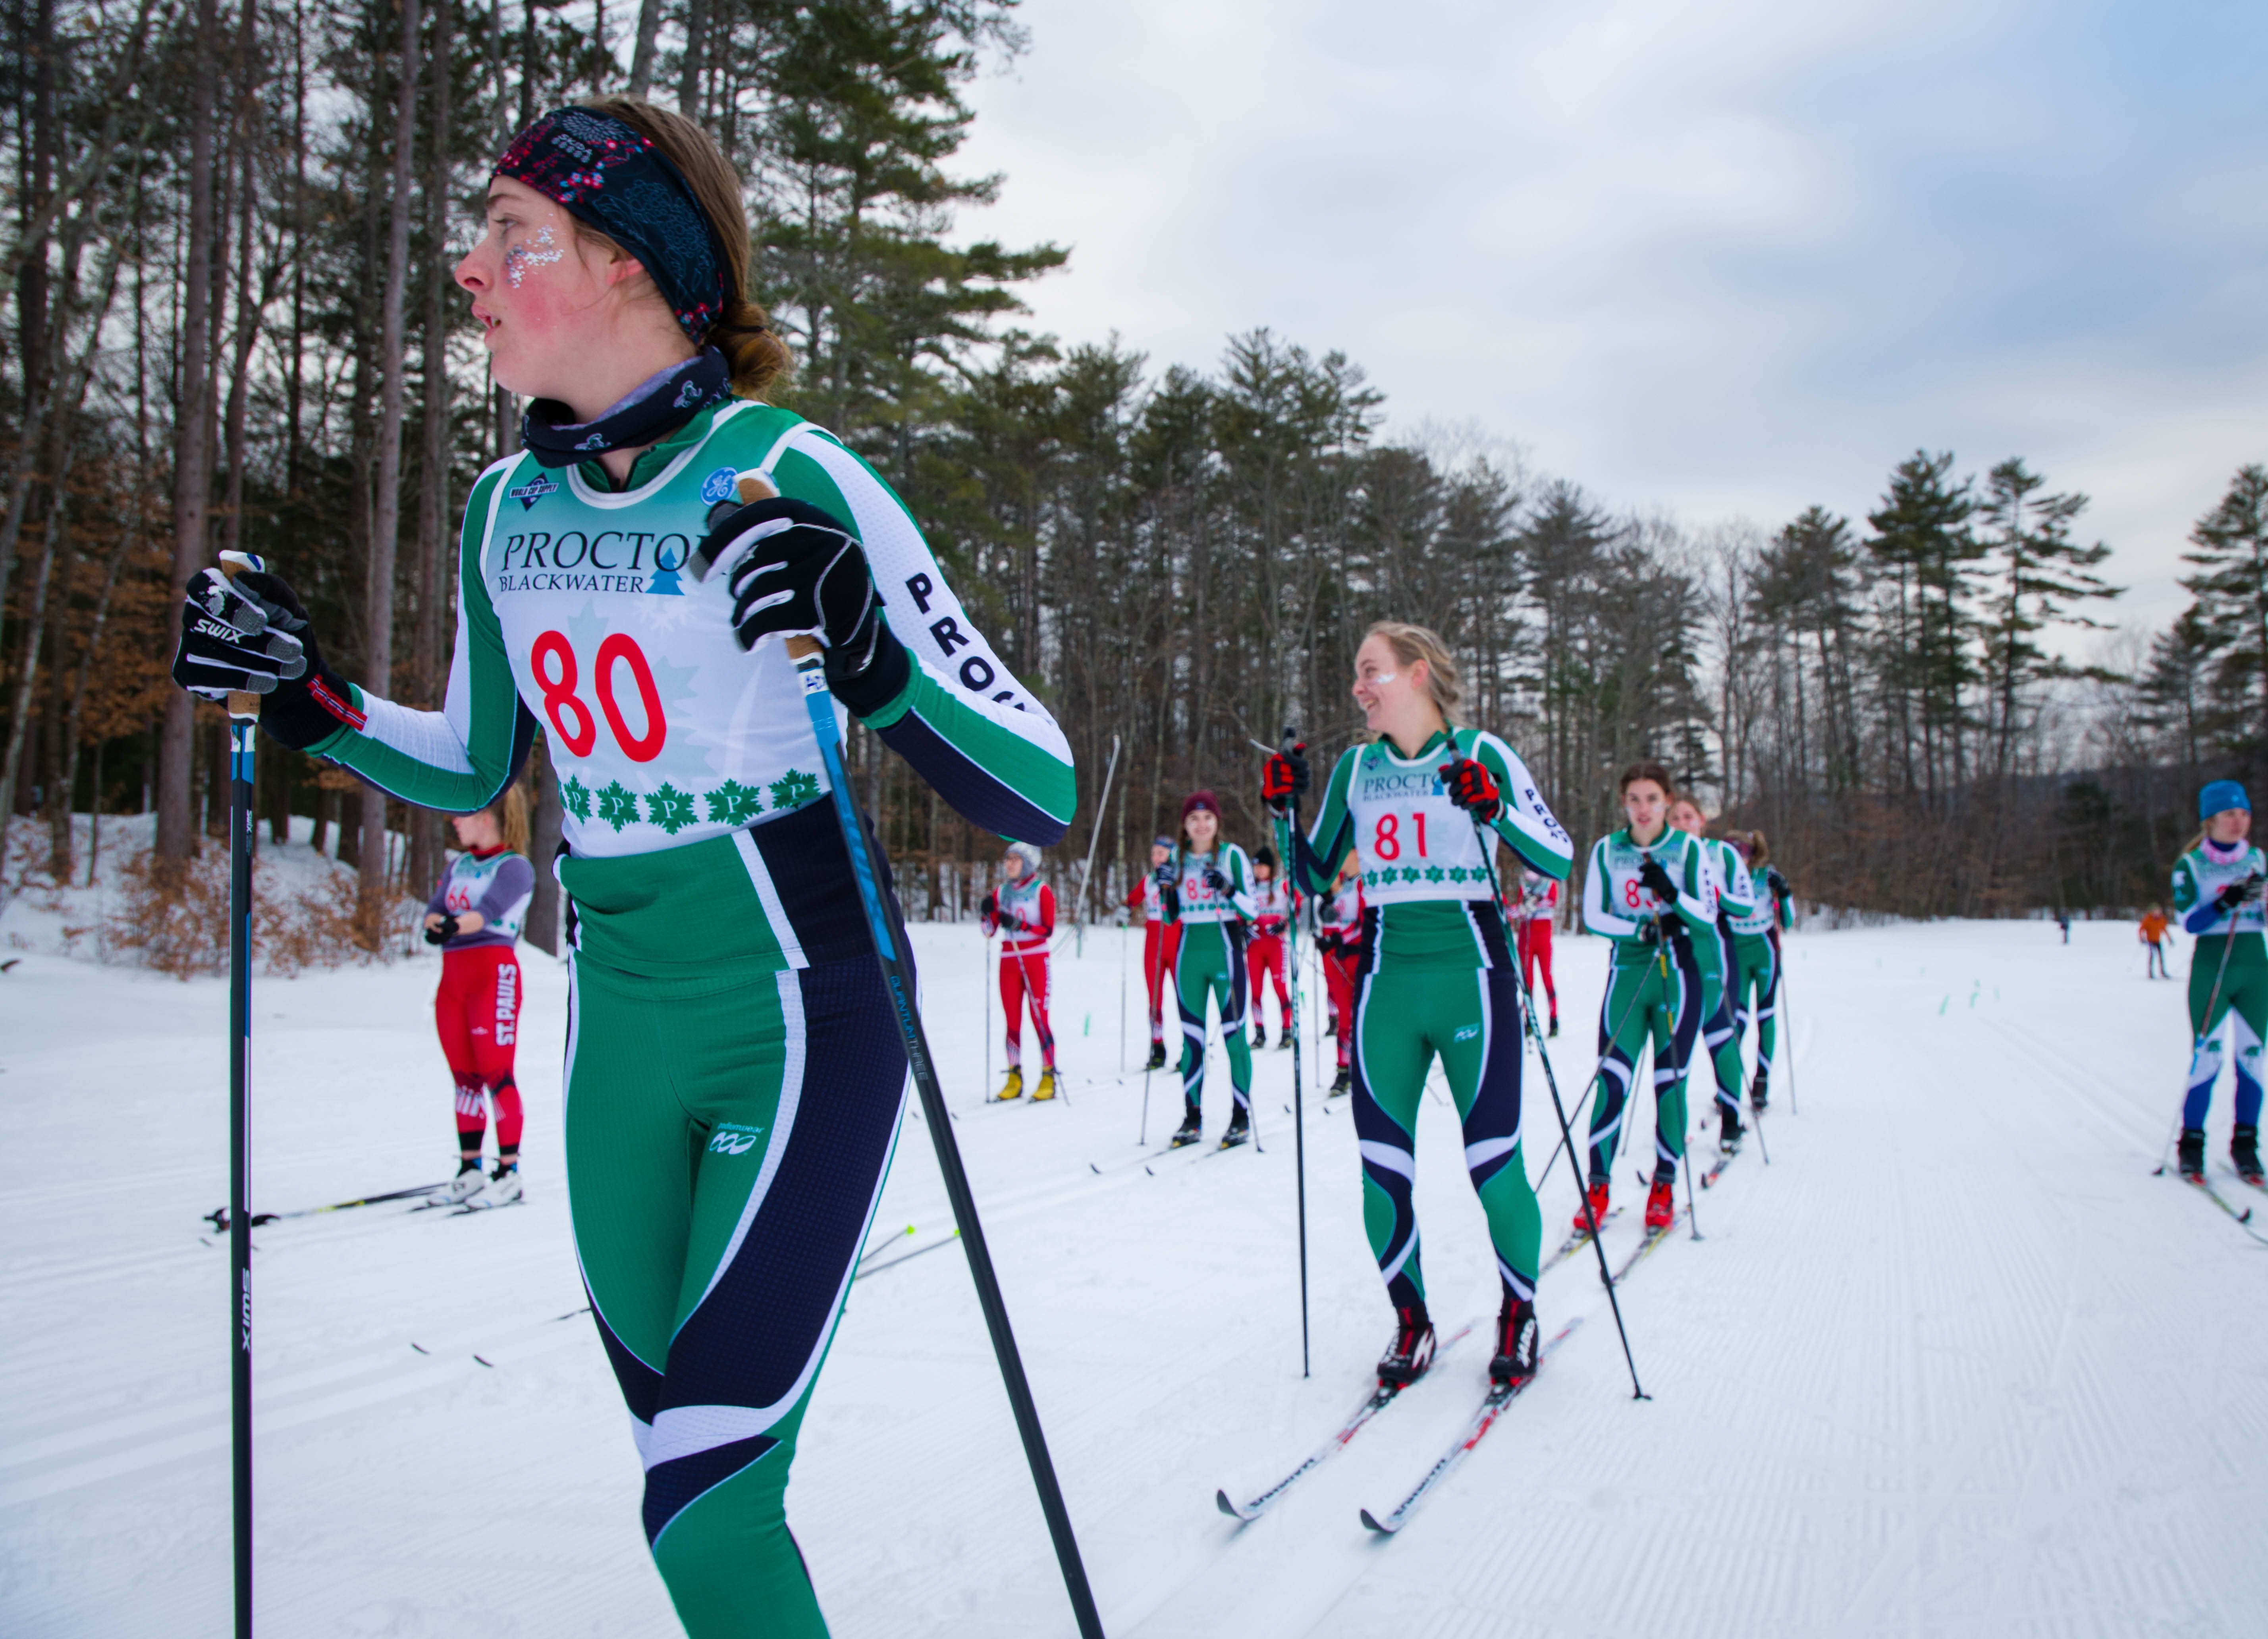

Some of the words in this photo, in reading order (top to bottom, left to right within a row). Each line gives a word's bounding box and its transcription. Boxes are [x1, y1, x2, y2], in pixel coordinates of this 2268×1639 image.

[501, 531, 727, 575] PROCTO
[499, 574, 643, 593] BLACKWATER
[194, 619, 243, 644] SWIX
[531, 630, 667, 762] 80
[572, 791, 581, 810] P
[612, 797, 624, 815] P
[663, 800, 677, 819] P
[727, 796, 742, 814] P
[791, 784, 806, 800] P
[1375, 813, 1427, 861] 81
[447, 885, 471, 912] 66
[242, 1268, 251, 1353] SWIX
